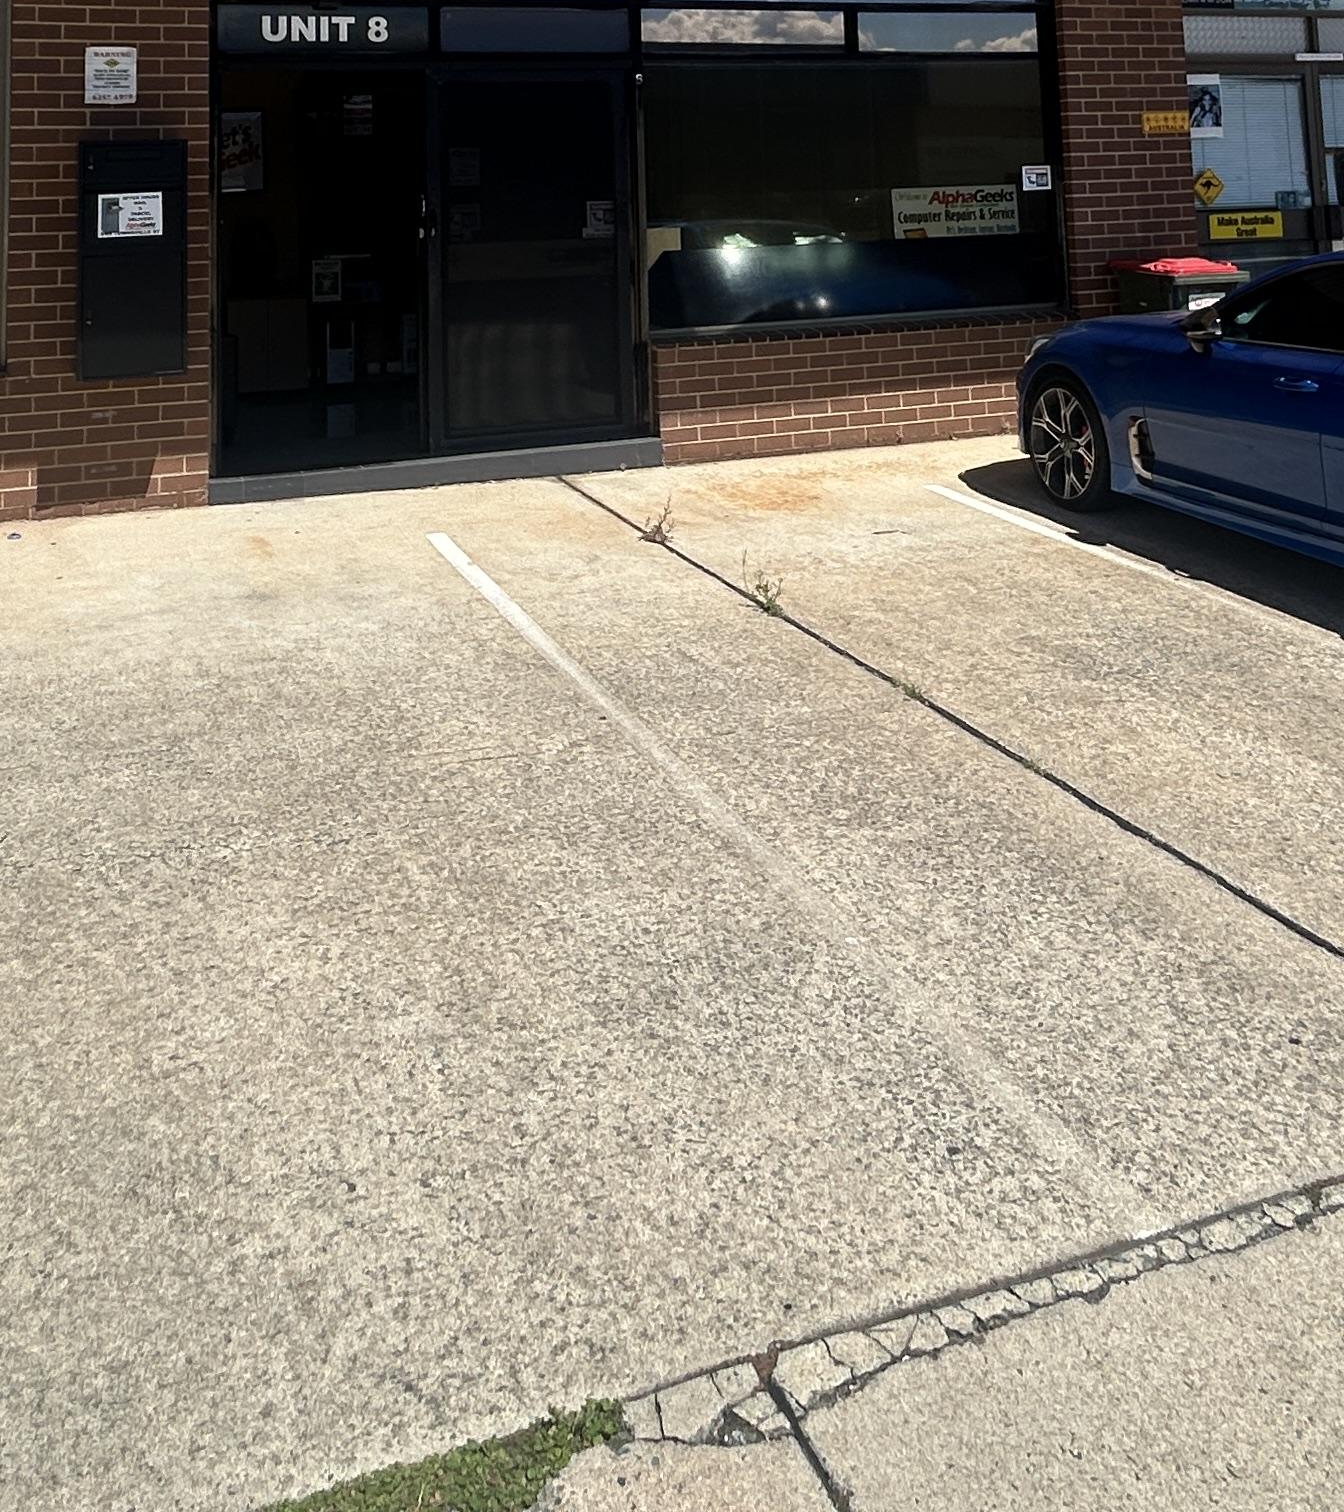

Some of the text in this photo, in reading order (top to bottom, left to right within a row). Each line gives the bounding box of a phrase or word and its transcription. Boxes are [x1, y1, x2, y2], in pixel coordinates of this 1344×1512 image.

[260, 14, 390, 44] UNIT 8
[928, 188, 1015, 208] AlphaGeeks
[897, 207, 1016, 224] Computer Repairs & Service
[1217, 214, 1275, 227] Make Australia
